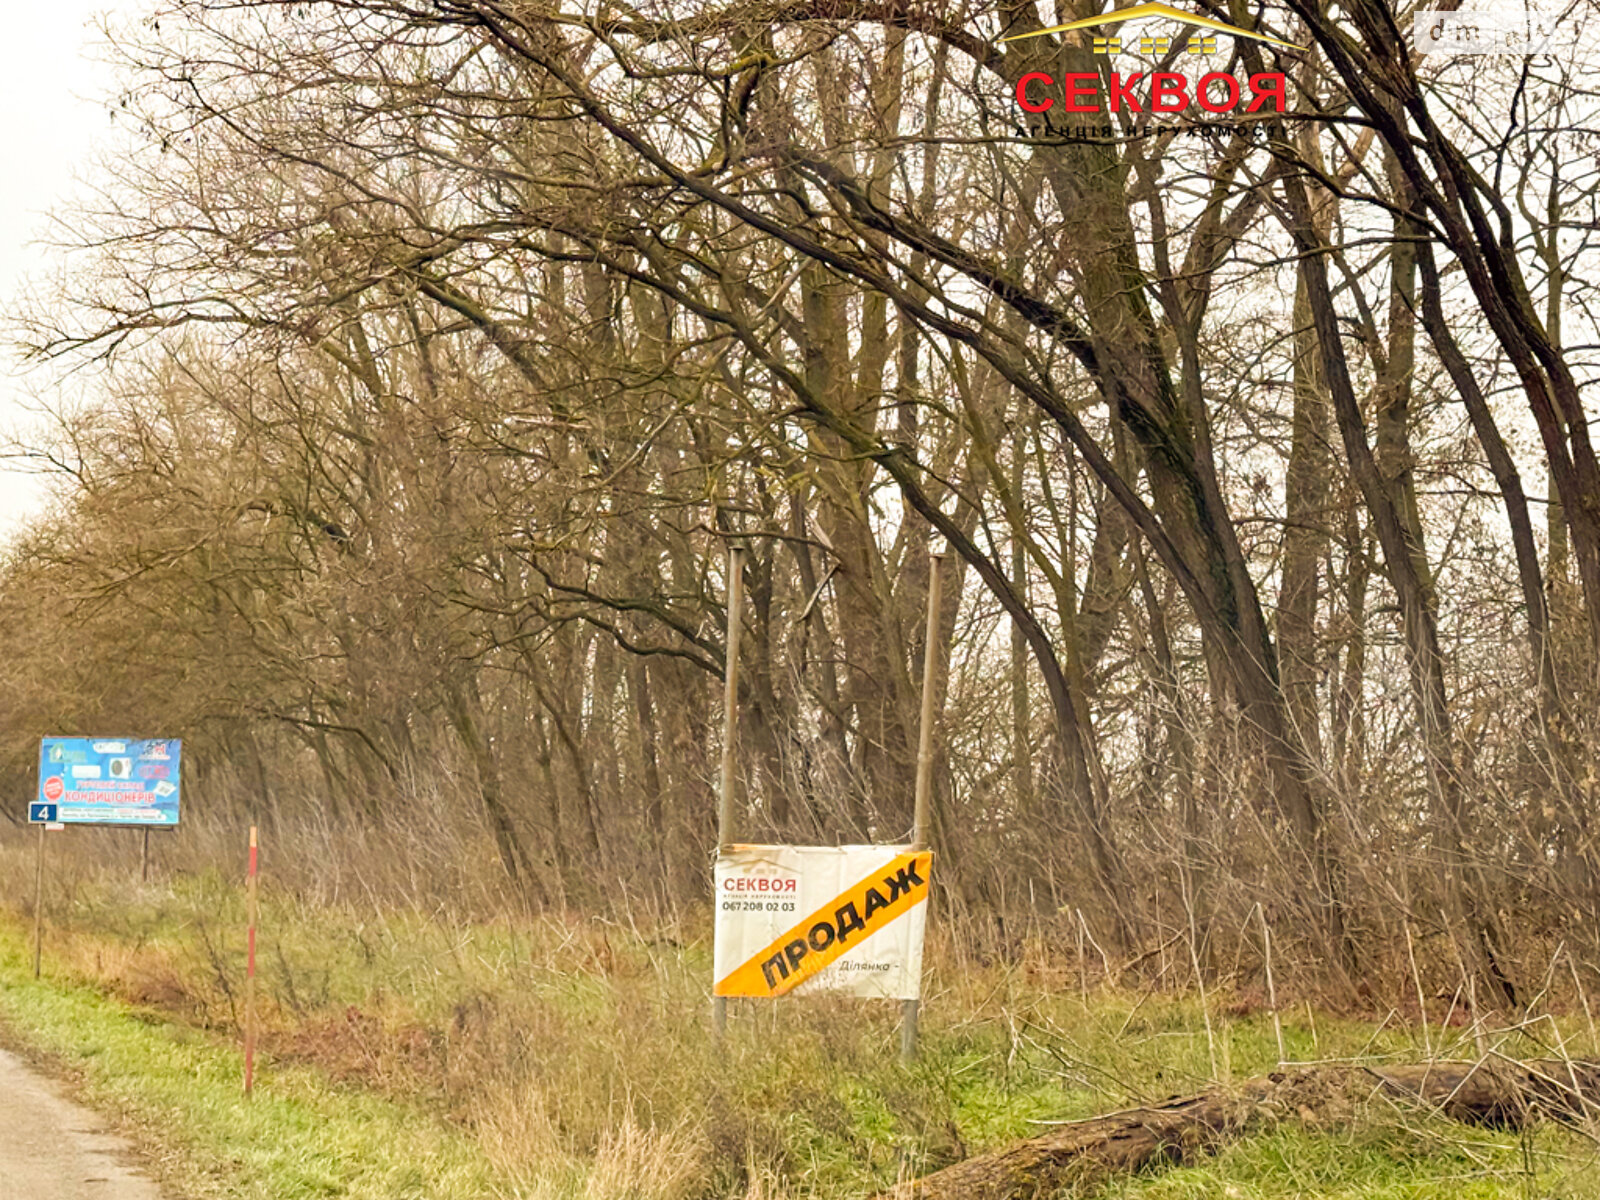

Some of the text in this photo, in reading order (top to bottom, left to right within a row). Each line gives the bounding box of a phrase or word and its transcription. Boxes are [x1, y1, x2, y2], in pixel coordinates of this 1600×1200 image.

[64, 791, 156, 803] КОНДИЦІОНЕРІВ
[38, 806, 49, 820] 4
[723, 878, 797, 892] СЕКВОЯ
[722, 901, 795, 911] 067 208 02 03
[761, 859, 924, 990] ПРОДАЖ
[839, 960, 890, 971] Ділянка
